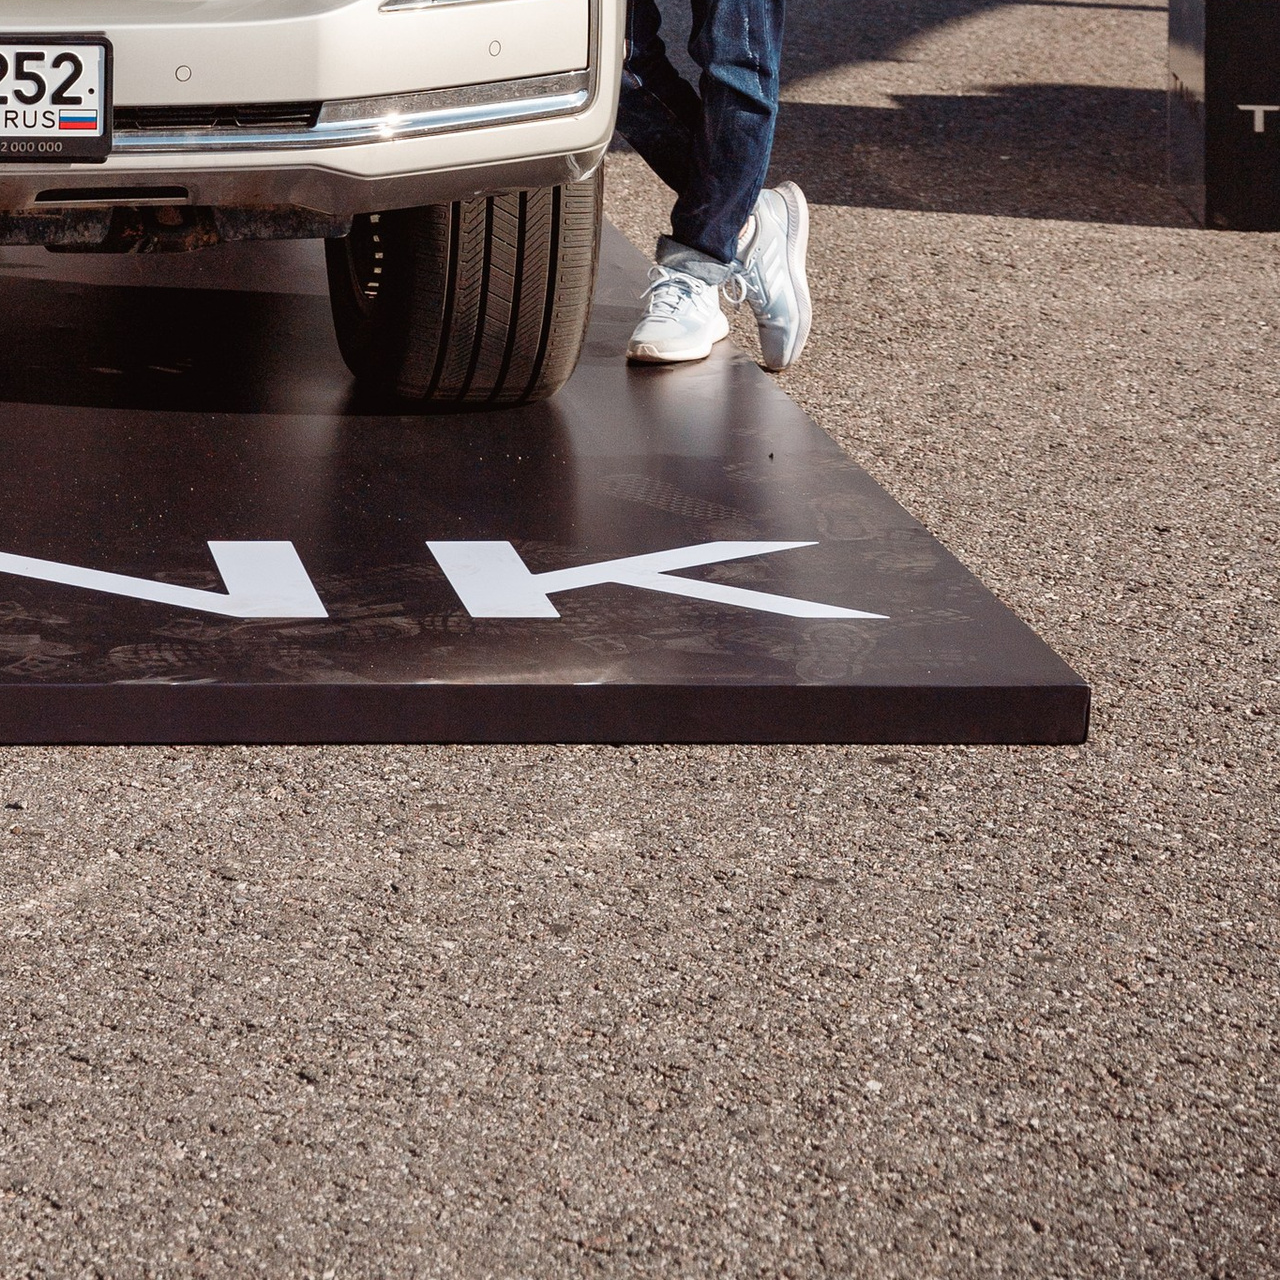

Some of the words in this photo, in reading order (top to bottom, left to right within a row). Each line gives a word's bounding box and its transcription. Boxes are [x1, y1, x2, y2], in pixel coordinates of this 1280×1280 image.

[4, 109, 56, 129] RUS
[1236, 104, 1280, 133] T
[0, 142, 8, 152] 2
[10, 142, 35, 152] 000
[38, 142, 63, 152] 000
